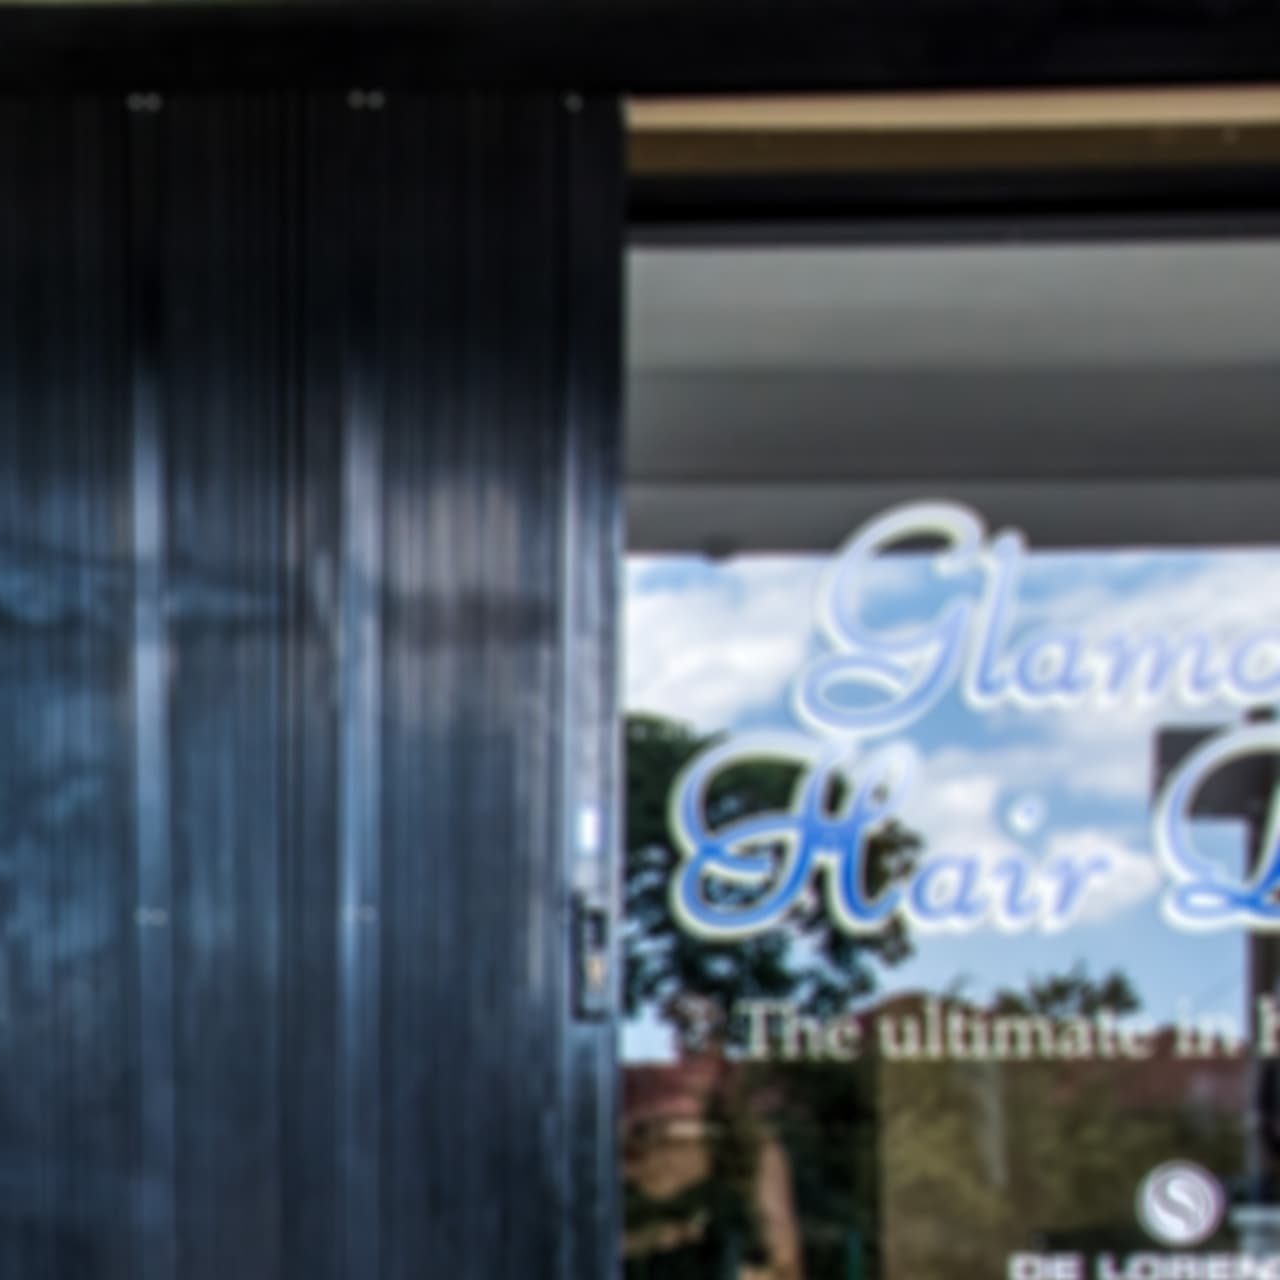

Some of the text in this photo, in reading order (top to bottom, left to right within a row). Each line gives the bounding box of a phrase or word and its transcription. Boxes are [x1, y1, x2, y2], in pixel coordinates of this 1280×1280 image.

[670, 733, 1112, 937] Hair
[737, 1000, 863, 1058] The
[878, 1000, 1152, 1058] ultimate
[1175, 1000, 1242, 1058] in
